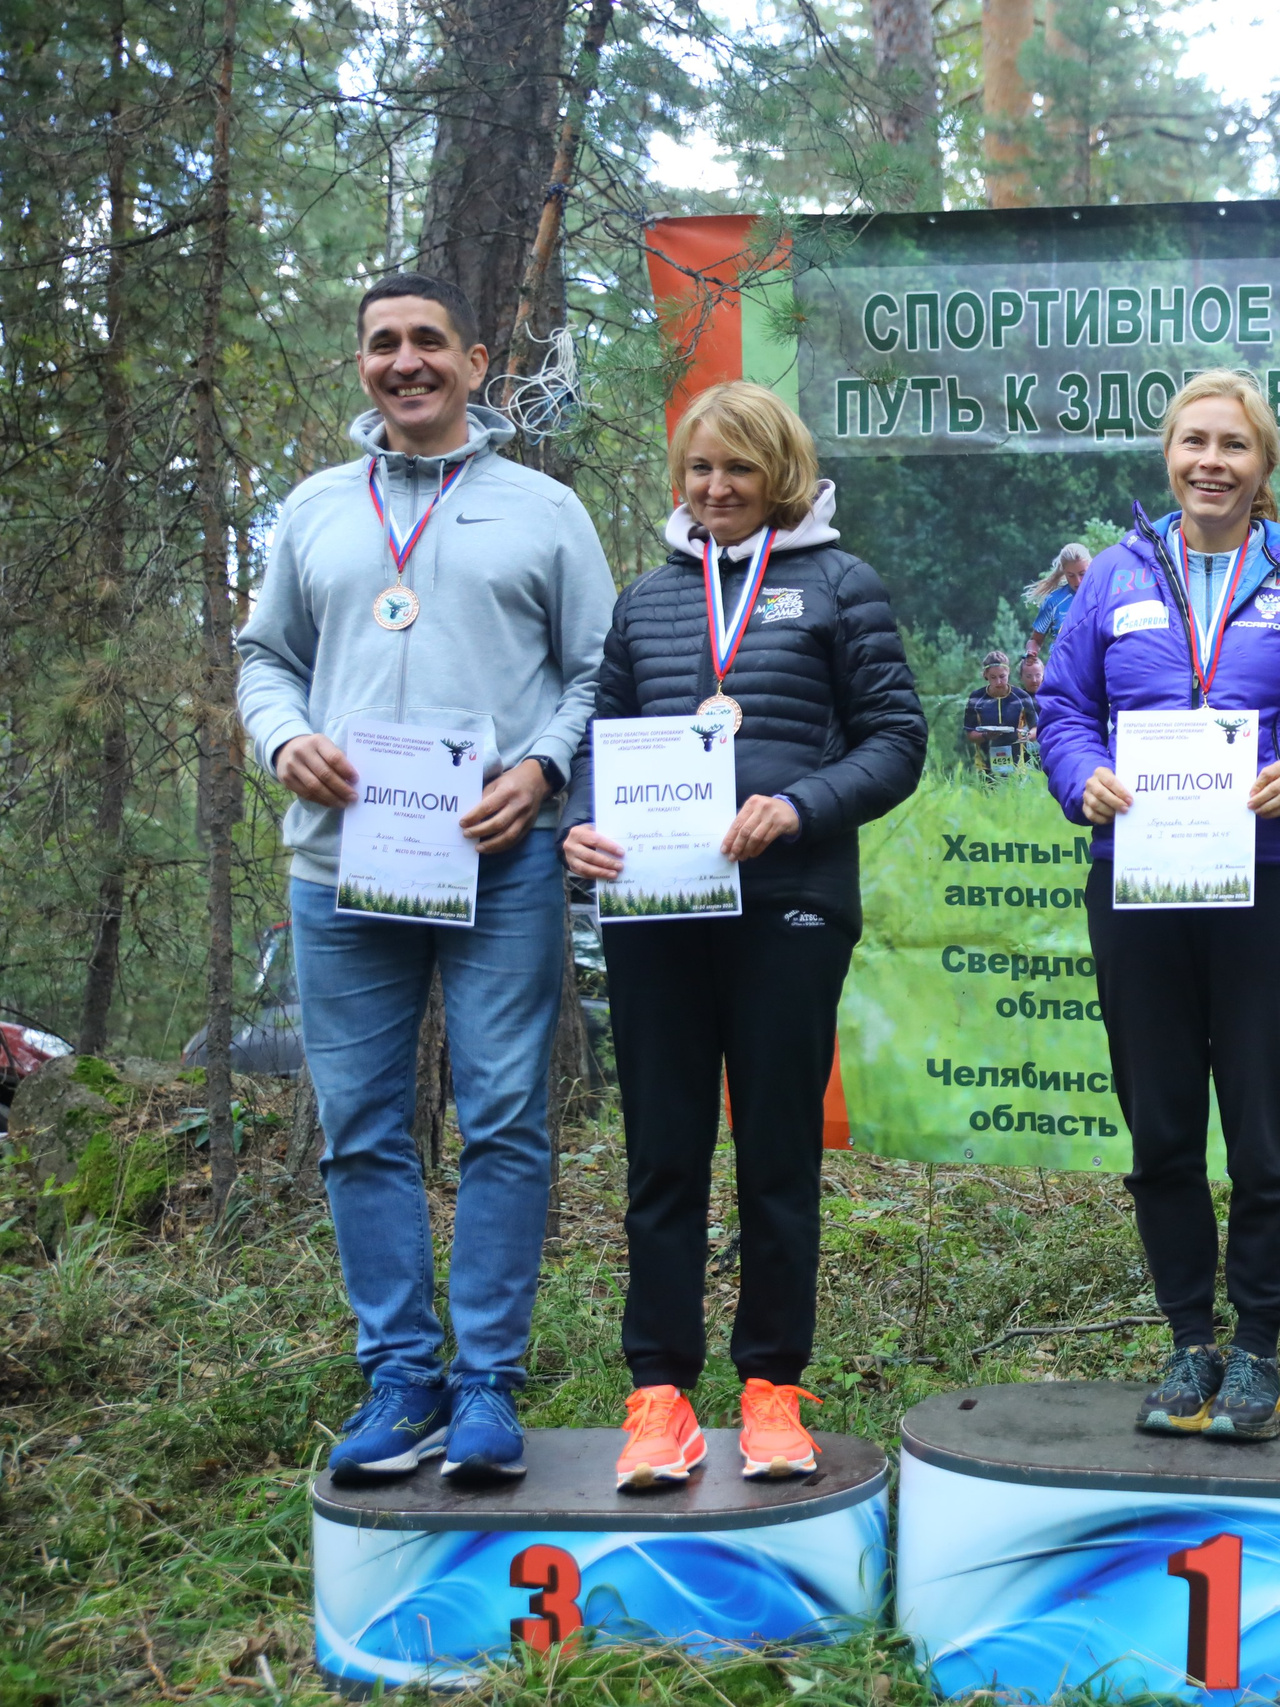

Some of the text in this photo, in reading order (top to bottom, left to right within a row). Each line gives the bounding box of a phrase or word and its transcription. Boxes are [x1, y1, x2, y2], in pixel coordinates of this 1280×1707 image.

[862, 283, 1272, 352] СПОРТИВНОЕ
[835, 375, 985, 437] ПУТЬ
[1005, 373, 1040, 433] К
[1112, 568, 1159, 596] RU
[364, 785, 459, 813] ДИПЛОМ
[615, 782, 712, 805] ДИПЛОМ
[1136, 773, 1232, 792] ДИПЛОМ
[942, 834, 1092, 865] Ханты-М
[941, 944, 1097, 982] Свердло
[995, 991, 1105, 1021] облас
[926, 1058, 1117, 1093] Челябинс
[969, 1104, 1118, 1138] область
[510, 1543, 584, 1659] 3
[1167, 1532, 1243, 1690] 1
